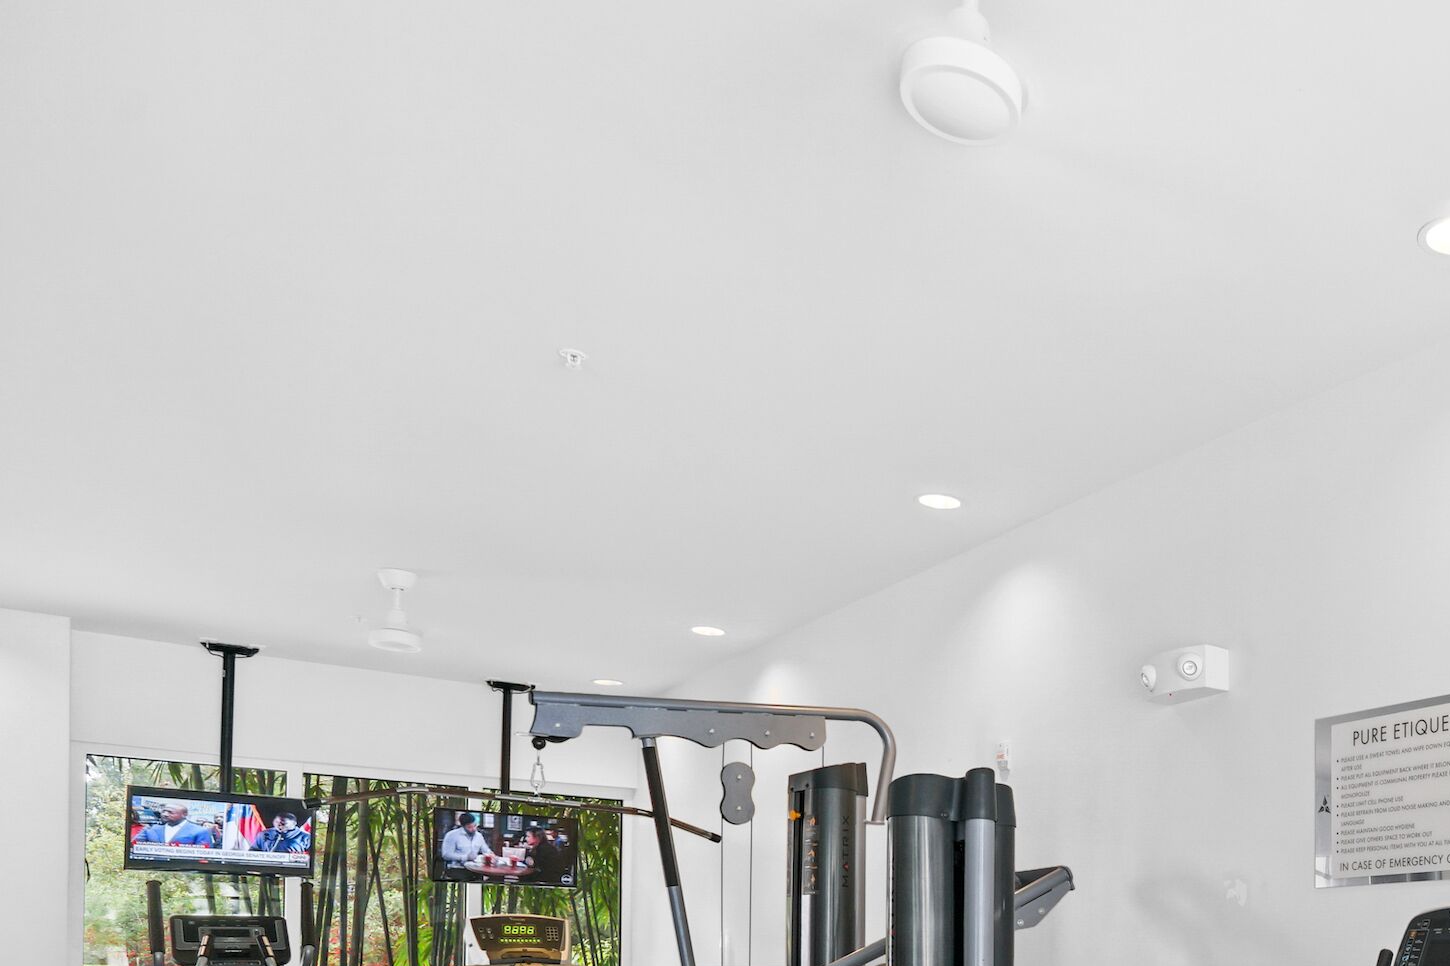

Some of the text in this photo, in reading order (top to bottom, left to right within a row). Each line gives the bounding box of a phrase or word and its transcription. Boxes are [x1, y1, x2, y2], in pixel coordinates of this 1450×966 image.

[1353, 725, 1387, 747] PURE
[842, 815, 850, 888] MATRIX
[1340, 861, 1349, 871] IN
[1351, 860, 1372, 870] CASE
[1375, 859, 1386, 869] OF
[1389, 854, 1444, 868] EMERGENCY
